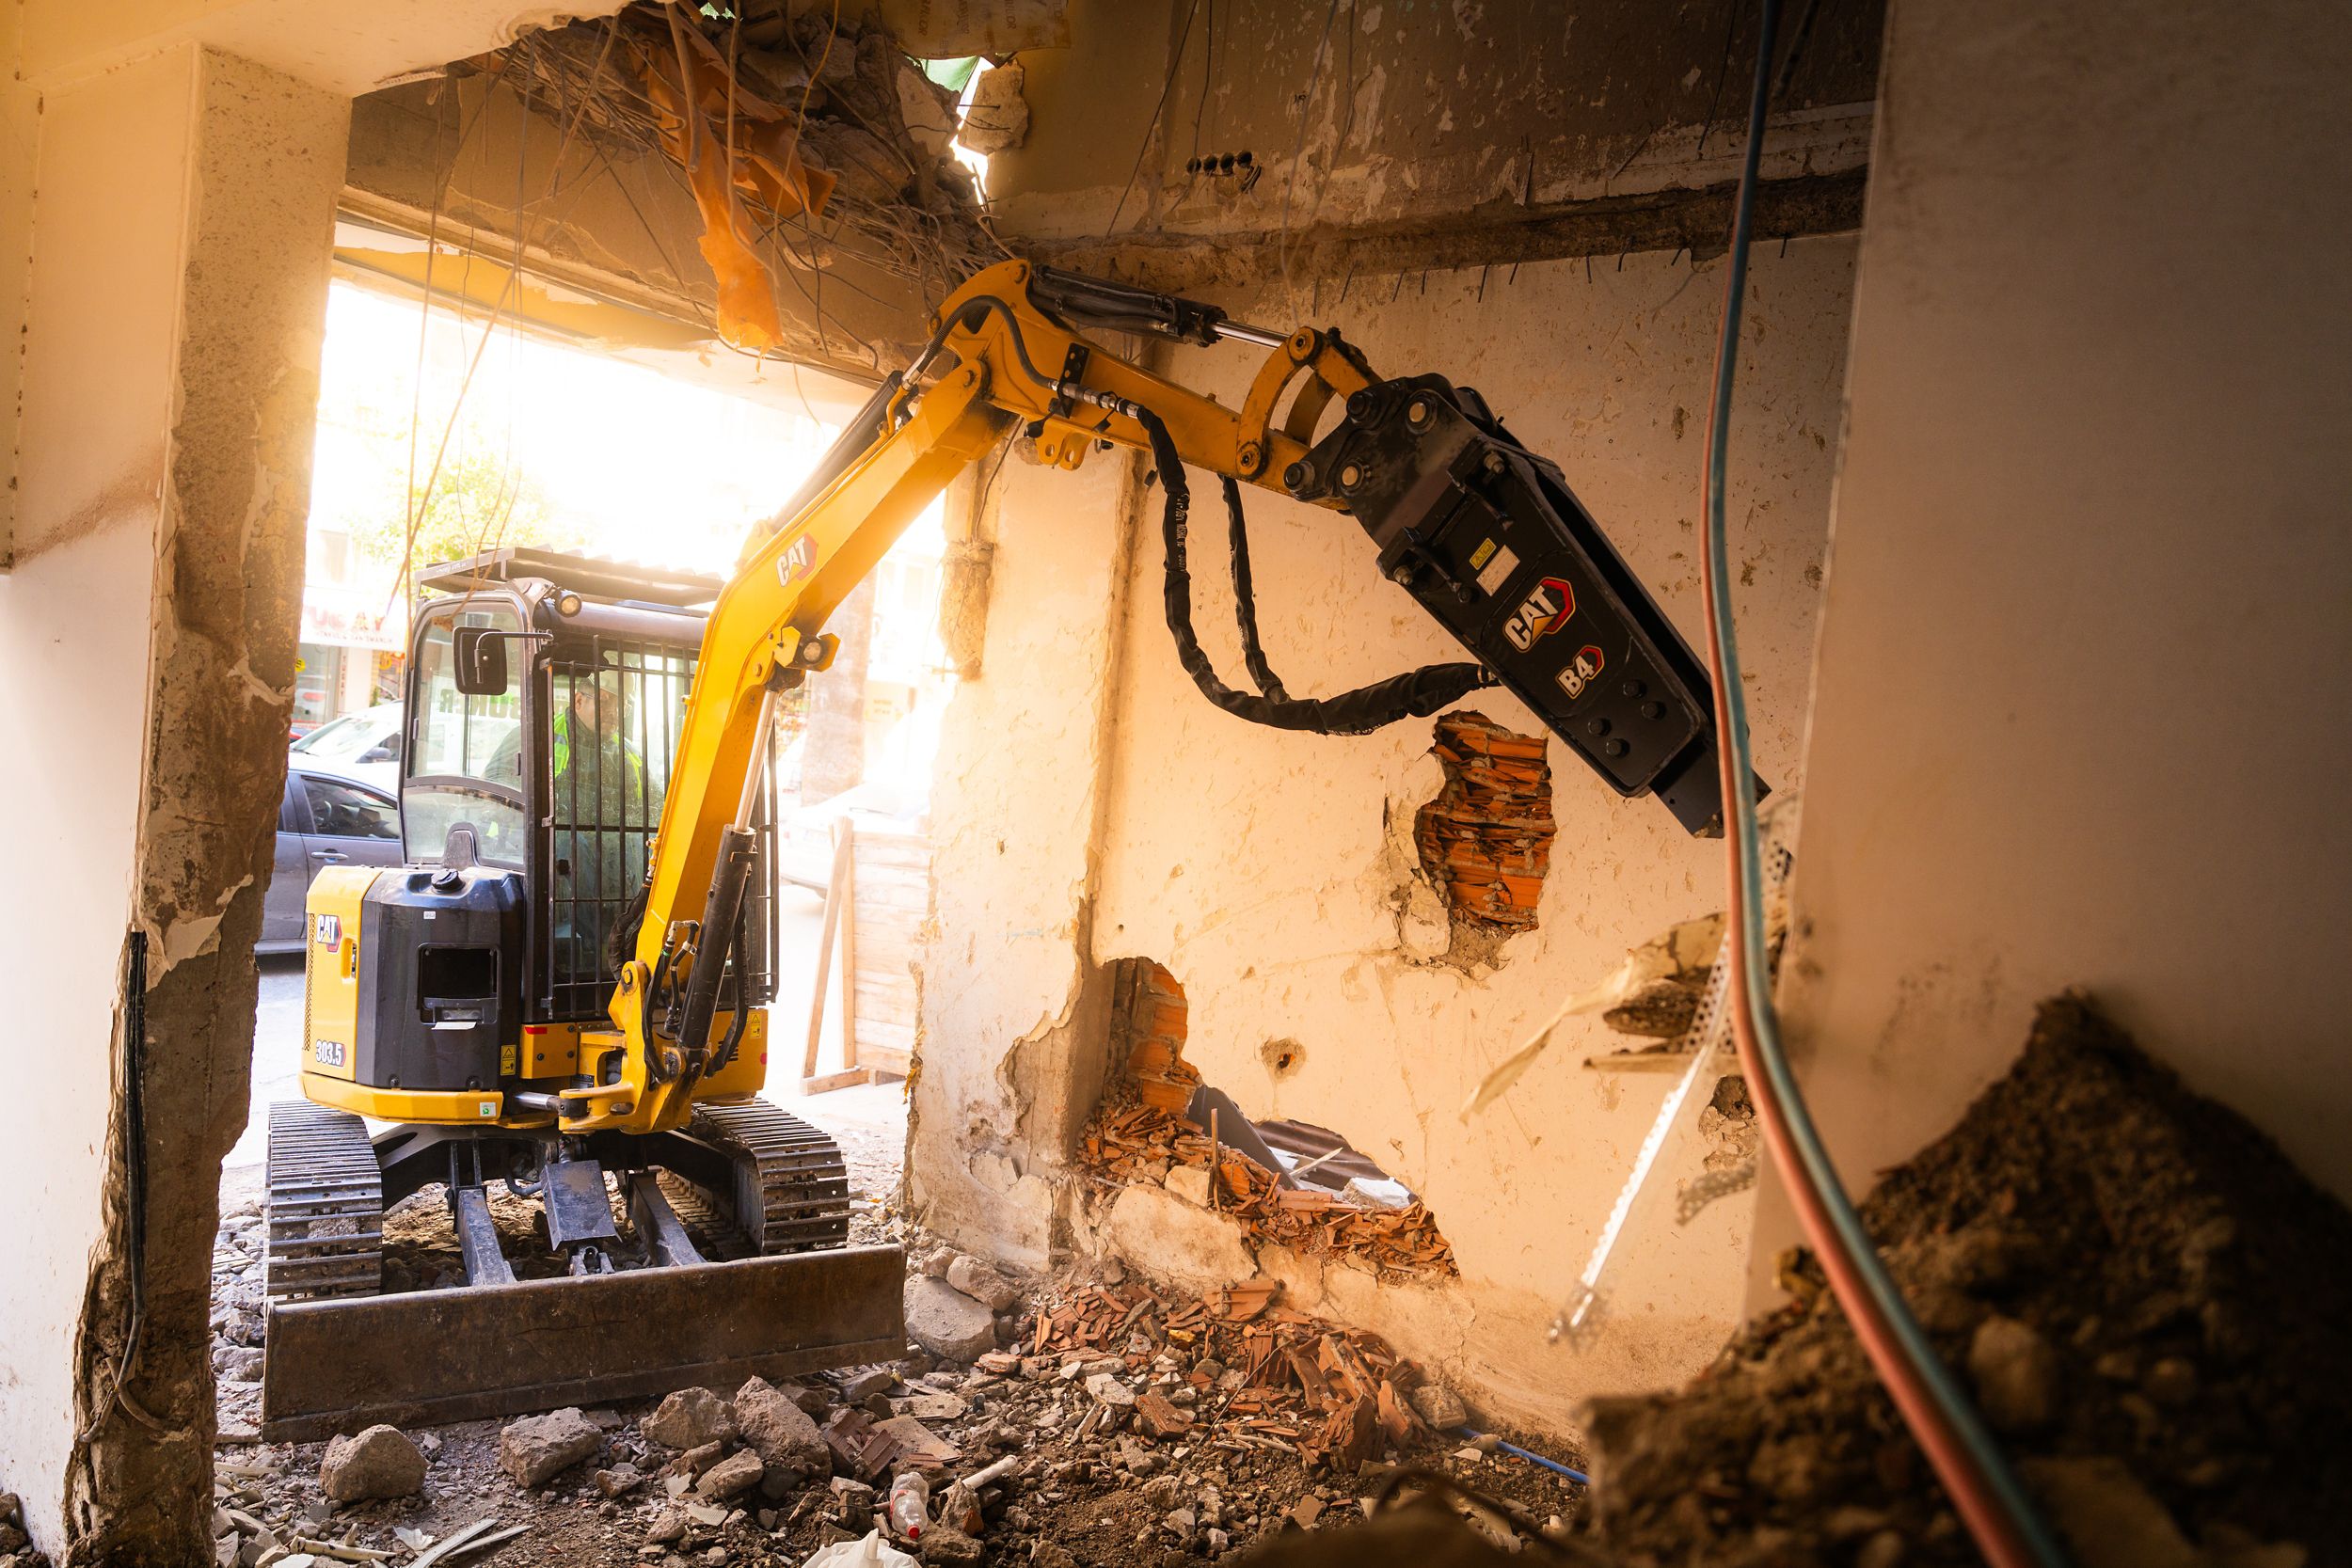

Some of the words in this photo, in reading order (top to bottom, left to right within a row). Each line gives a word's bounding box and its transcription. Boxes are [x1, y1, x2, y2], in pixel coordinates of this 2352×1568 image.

[776, 536, 808, 587] CAT
[1504, 584, 1559, 651] CAT
[1557, 655, 1596, 696] B4
[316, 914, 337, 943] CAT
[315, 1038, 342, 1065] 303.5
